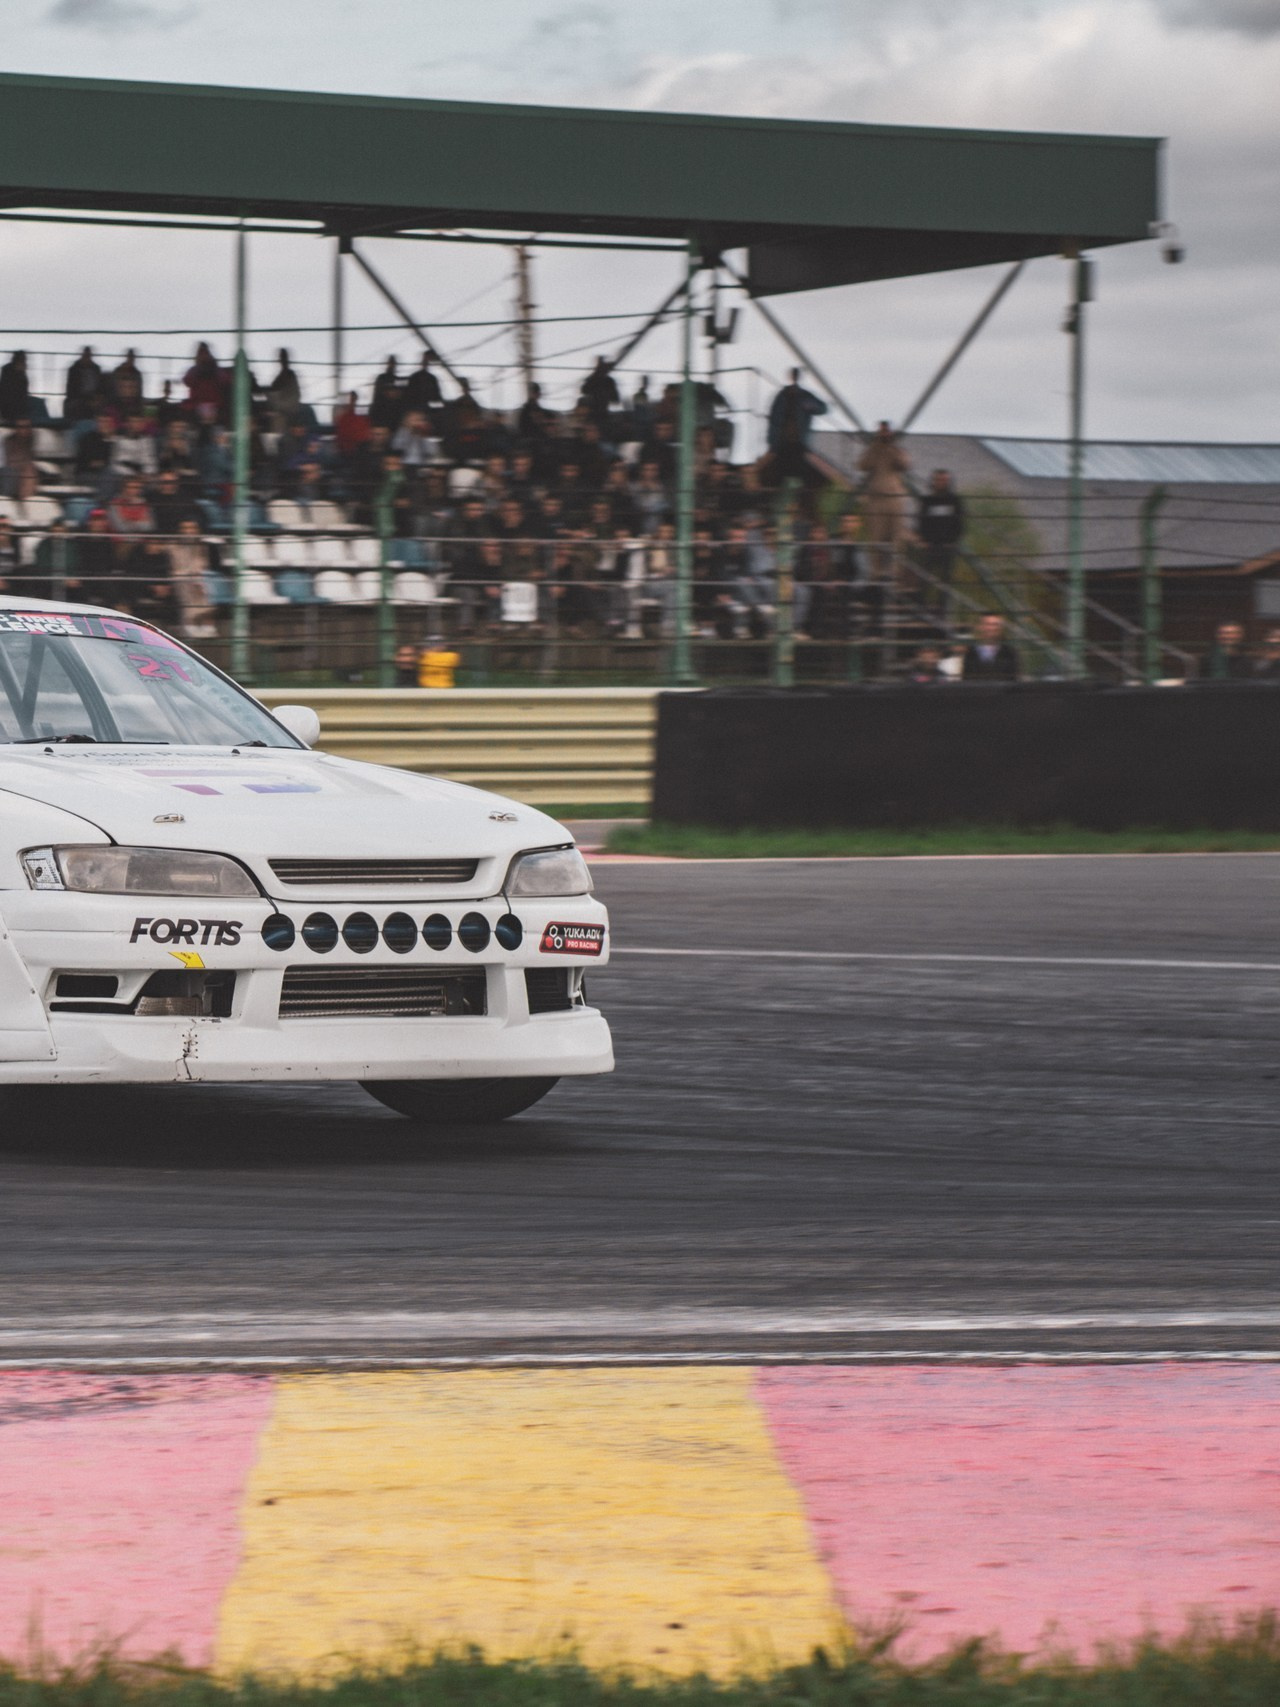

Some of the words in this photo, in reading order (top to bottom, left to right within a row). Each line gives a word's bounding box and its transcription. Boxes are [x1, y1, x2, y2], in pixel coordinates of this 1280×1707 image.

[12, 614, 74, 625] TIRES
[127, 653, 193, 683] 21
[129, 917, 243, 946] FORTIS
[563, 927, 586, 939] YUKA
[567, 940, 579, 948] PRO
[579, 941, 598, 950] RACING
